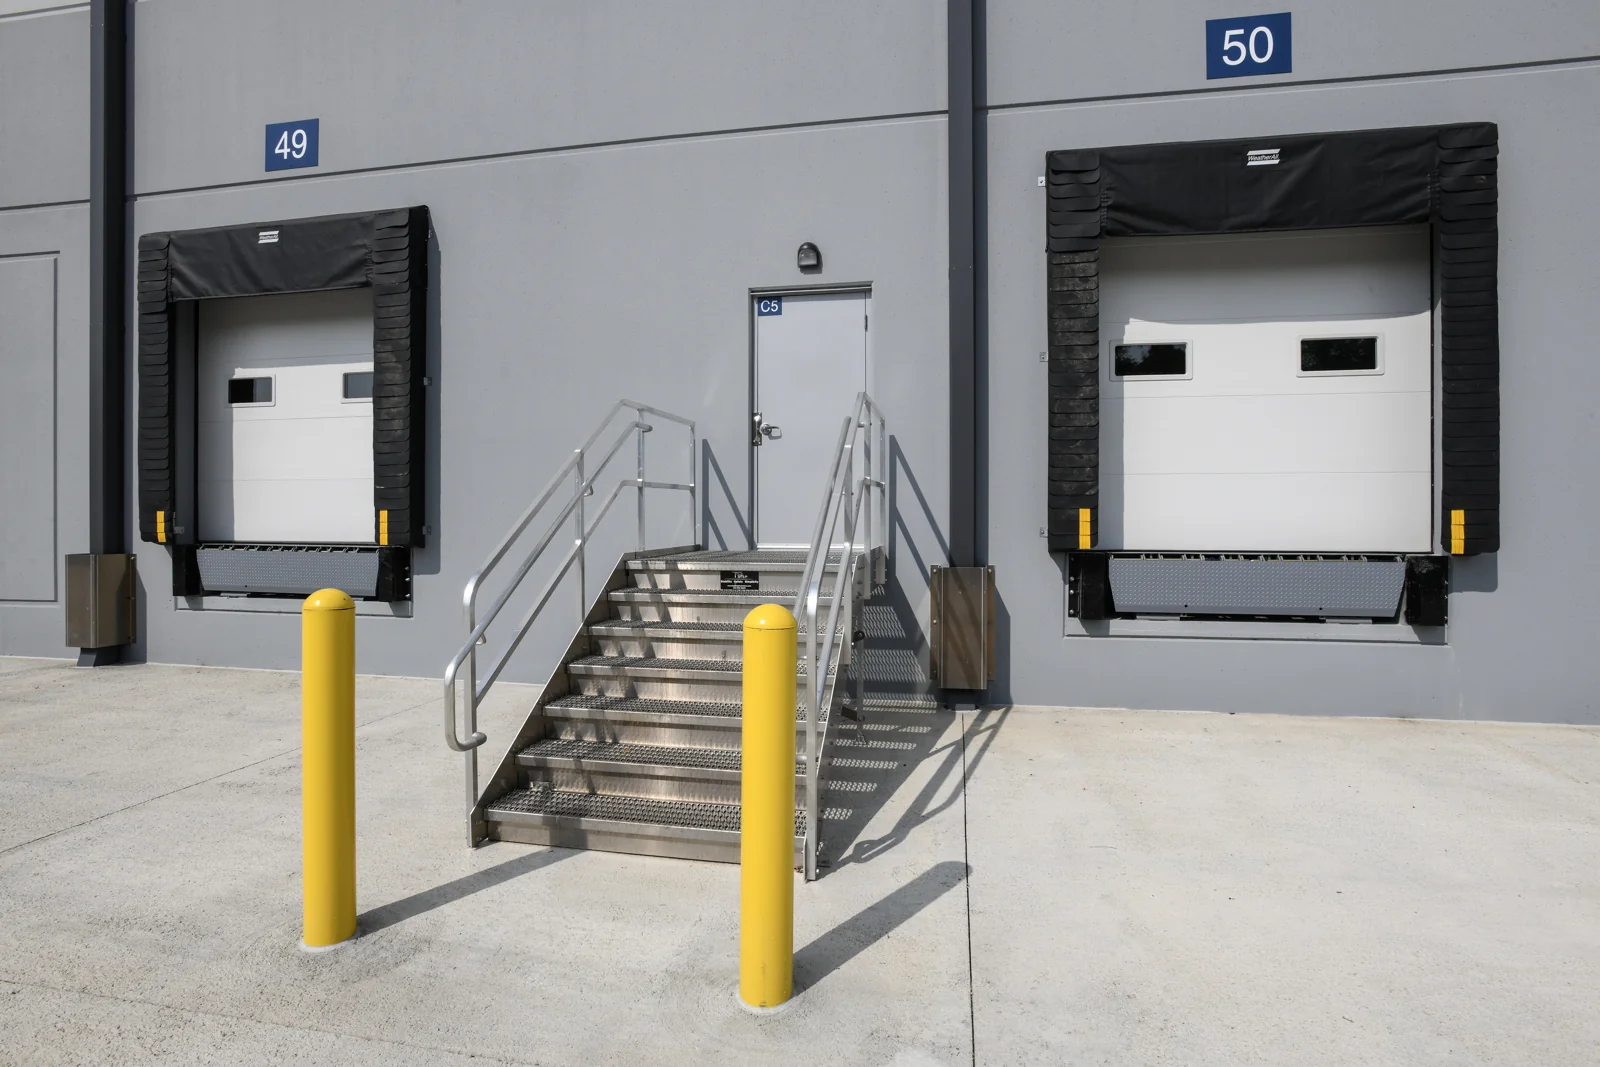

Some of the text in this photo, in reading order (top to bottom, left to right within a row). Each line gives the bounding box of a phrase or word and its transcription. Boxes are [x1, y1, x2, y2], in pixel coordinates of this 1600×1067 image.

[1222, 26, 1274, 66] 50
[274, 128, 307, 160] 49
[760, 299, 779, 313] C5
